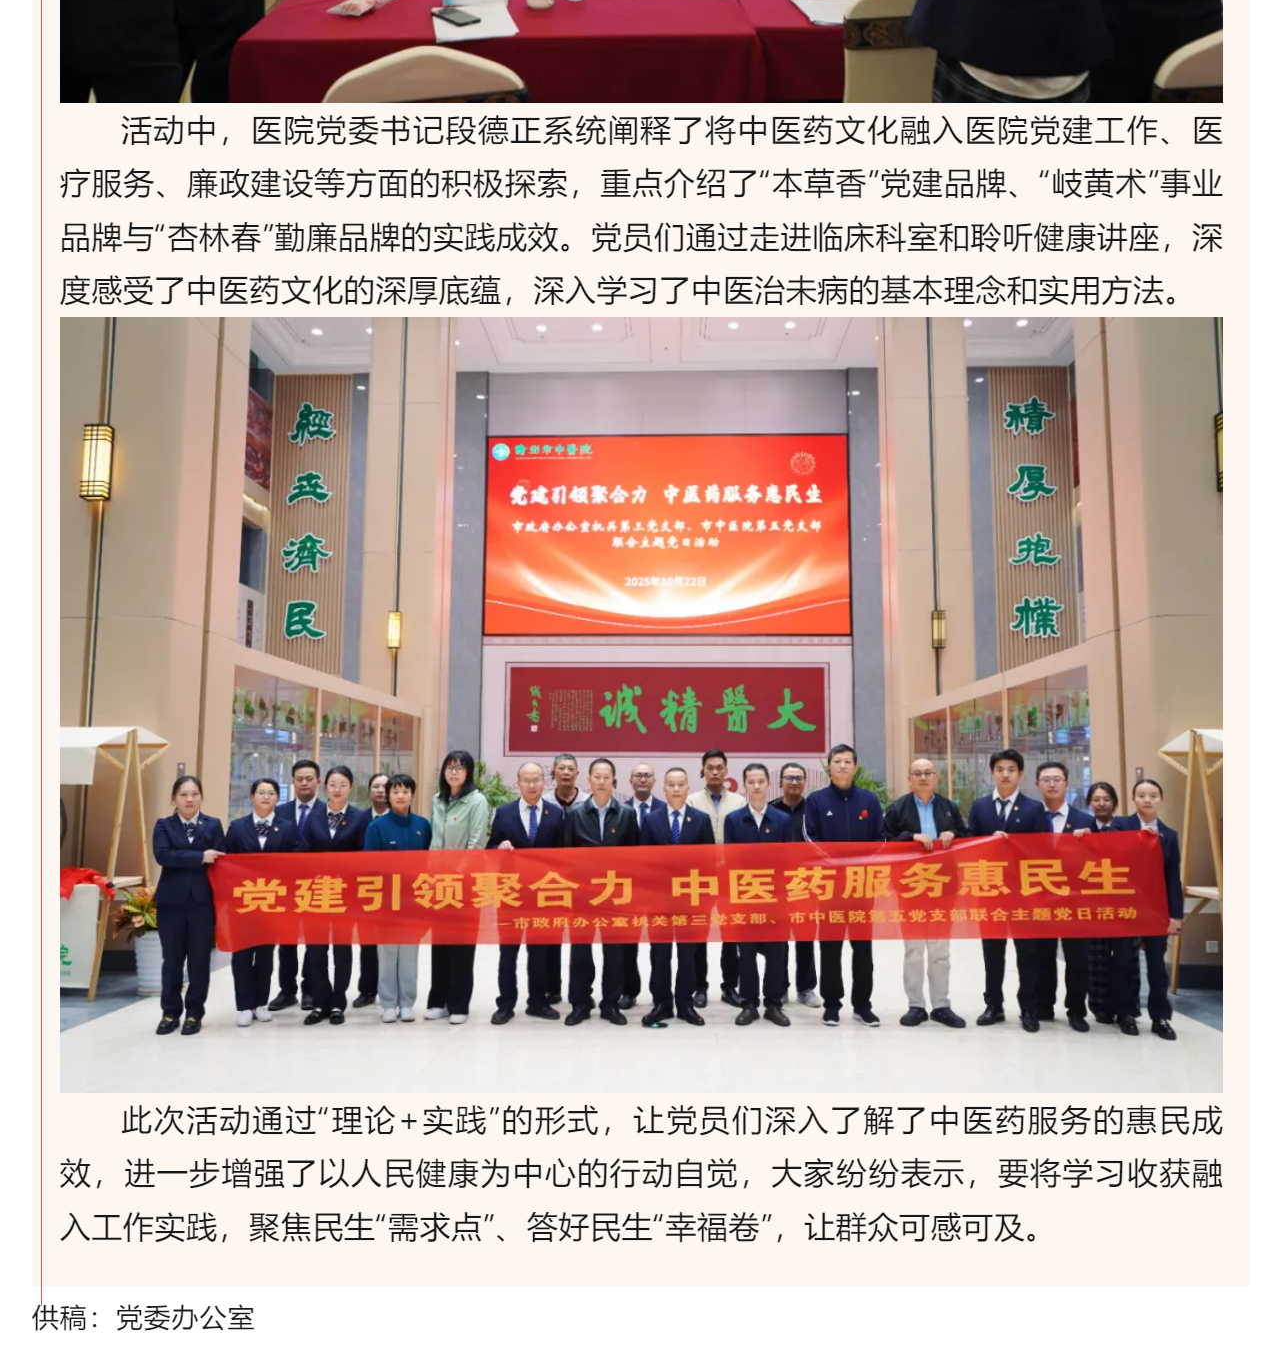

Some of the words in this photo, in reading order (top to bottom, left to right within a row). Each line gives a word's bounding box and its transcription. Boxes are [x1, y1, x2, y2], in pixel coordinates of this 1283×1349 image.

[510, 485, 648, 506] 党建引领聚合力
[663, 484, 823, 505] 中医药服务惠民生
[512, 519, 822, 533] 市政府办公室机关第三党支部、市中医院第五党支部
[612, 536, 719, 549] 联合主题党日活动
[625, 576, 707, 587] 2025年10月22日
[232, 870, 634, 914] 党建引领聚合力
[672, 858, 1137, 907] 中医药服务惠民生
